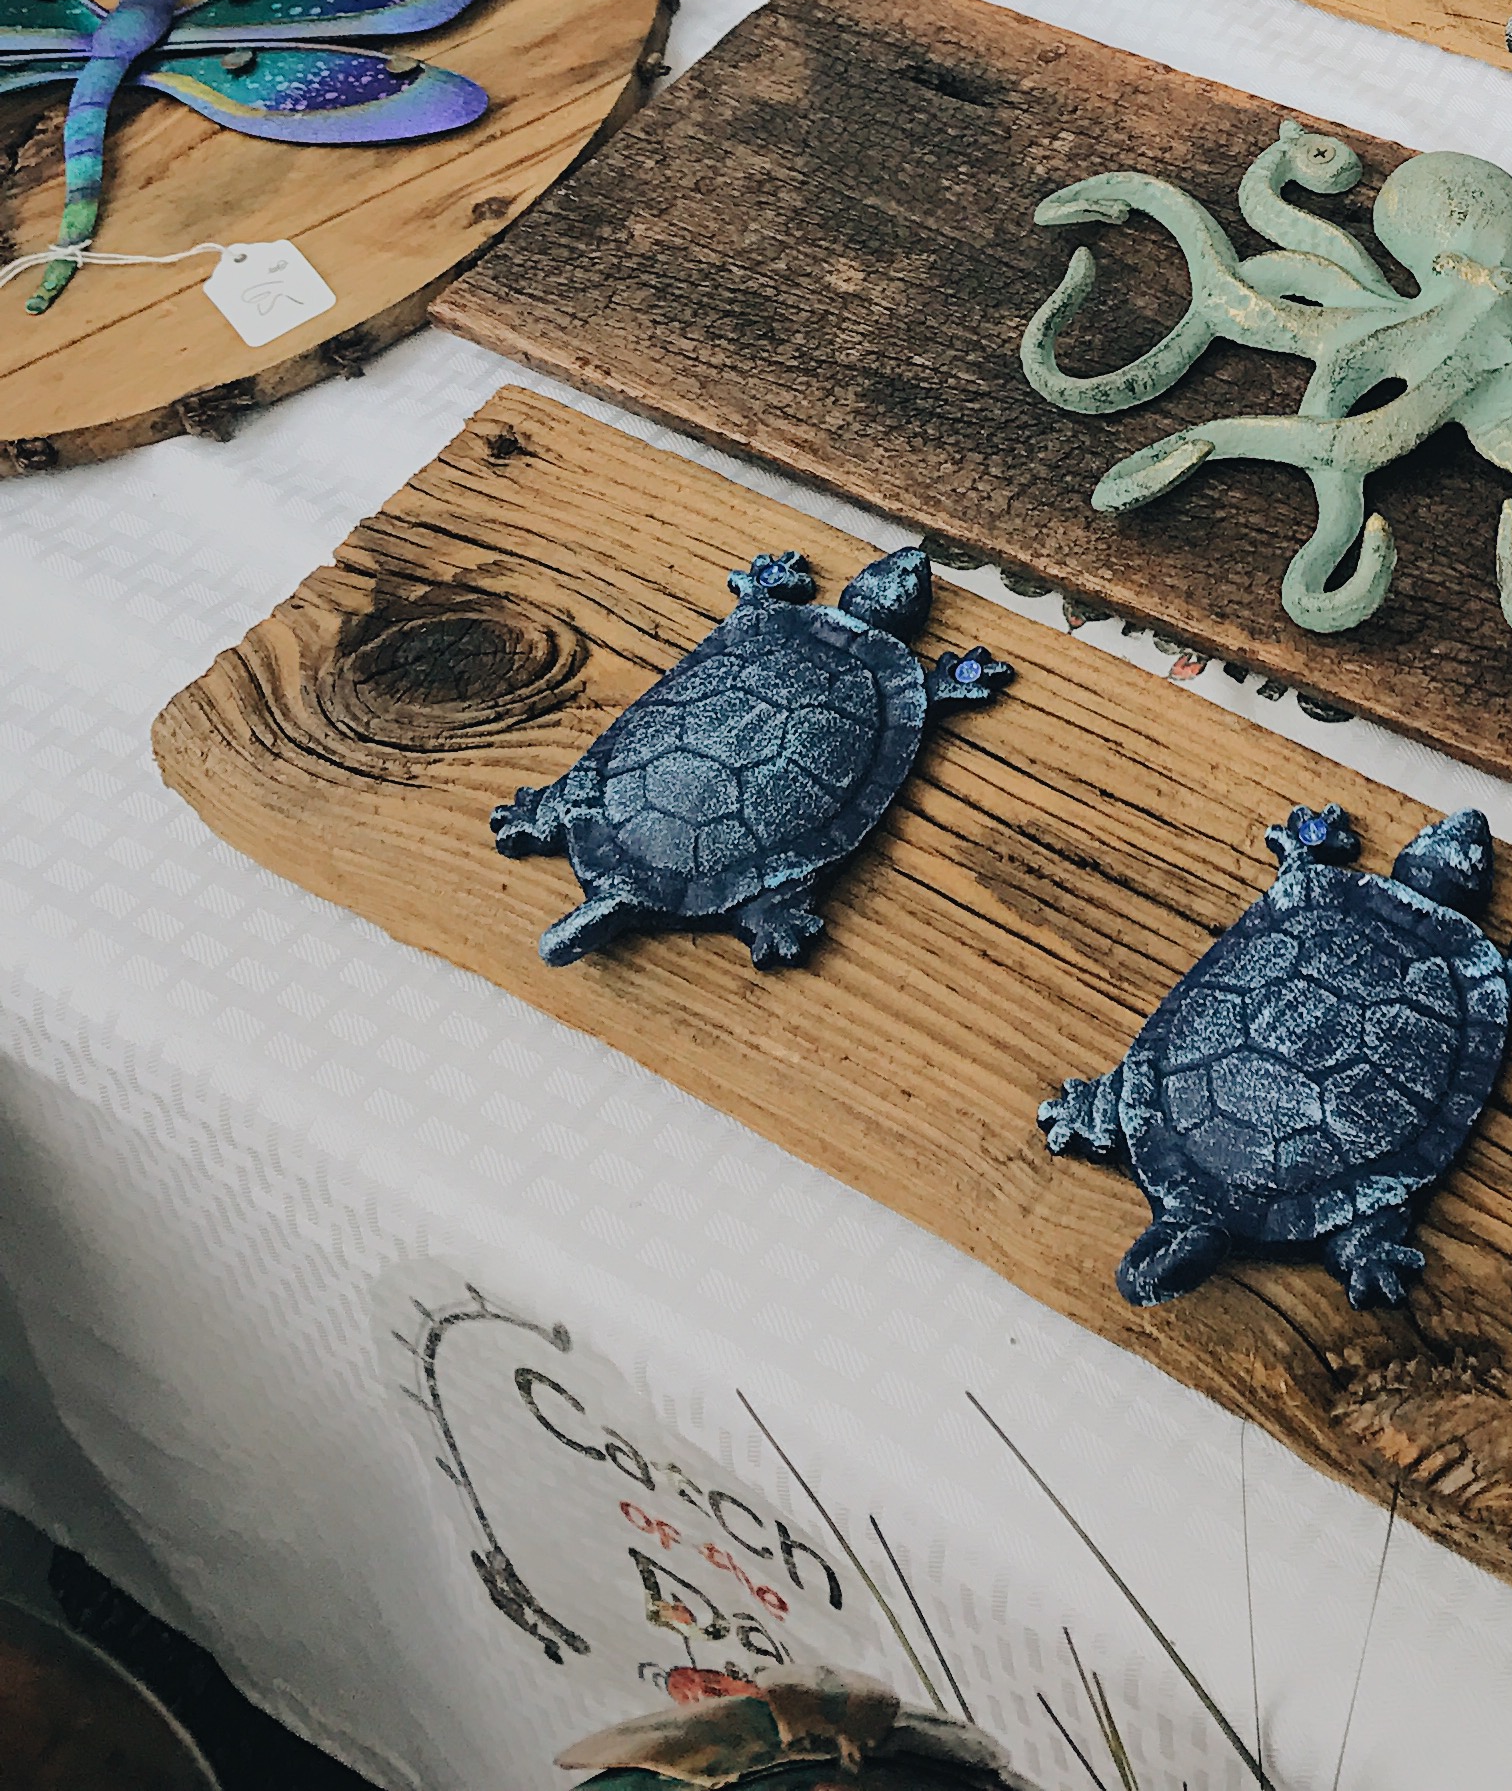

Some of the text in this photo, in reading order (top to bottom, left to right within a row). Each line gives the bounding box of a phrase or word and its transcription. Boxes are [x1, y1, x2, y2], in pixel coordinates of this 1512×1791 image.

[514, 1367, 843, 1610] Catch
[619, 1501, 789, 1622] of the
[628, 1547, 795, 1665] Da
